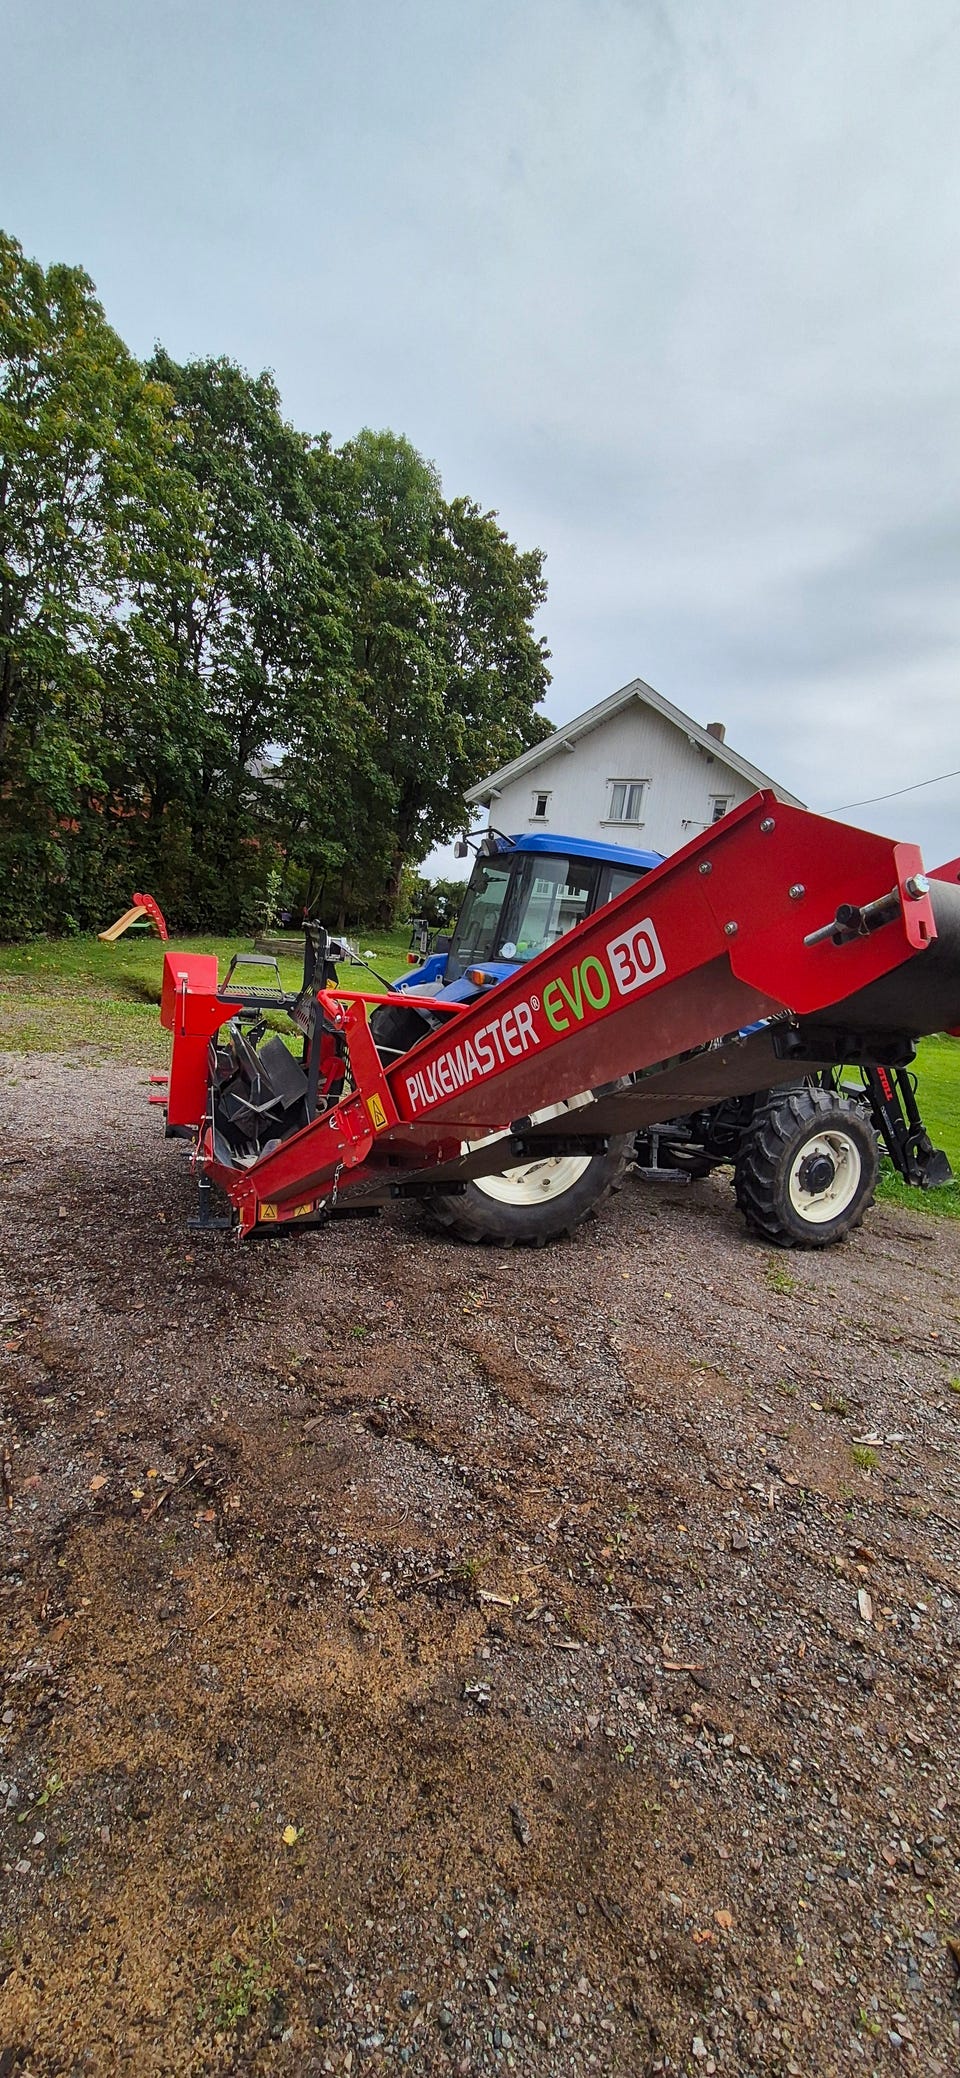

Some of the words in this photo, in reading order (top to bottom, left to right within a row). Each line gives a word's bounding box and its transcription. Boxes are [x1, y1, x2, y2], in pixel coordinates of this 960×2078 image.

[543, 956, 611, 1032] EVO
[613, 931, 657, 987] 30
[877, 1067, 893, 1101] STOLL
